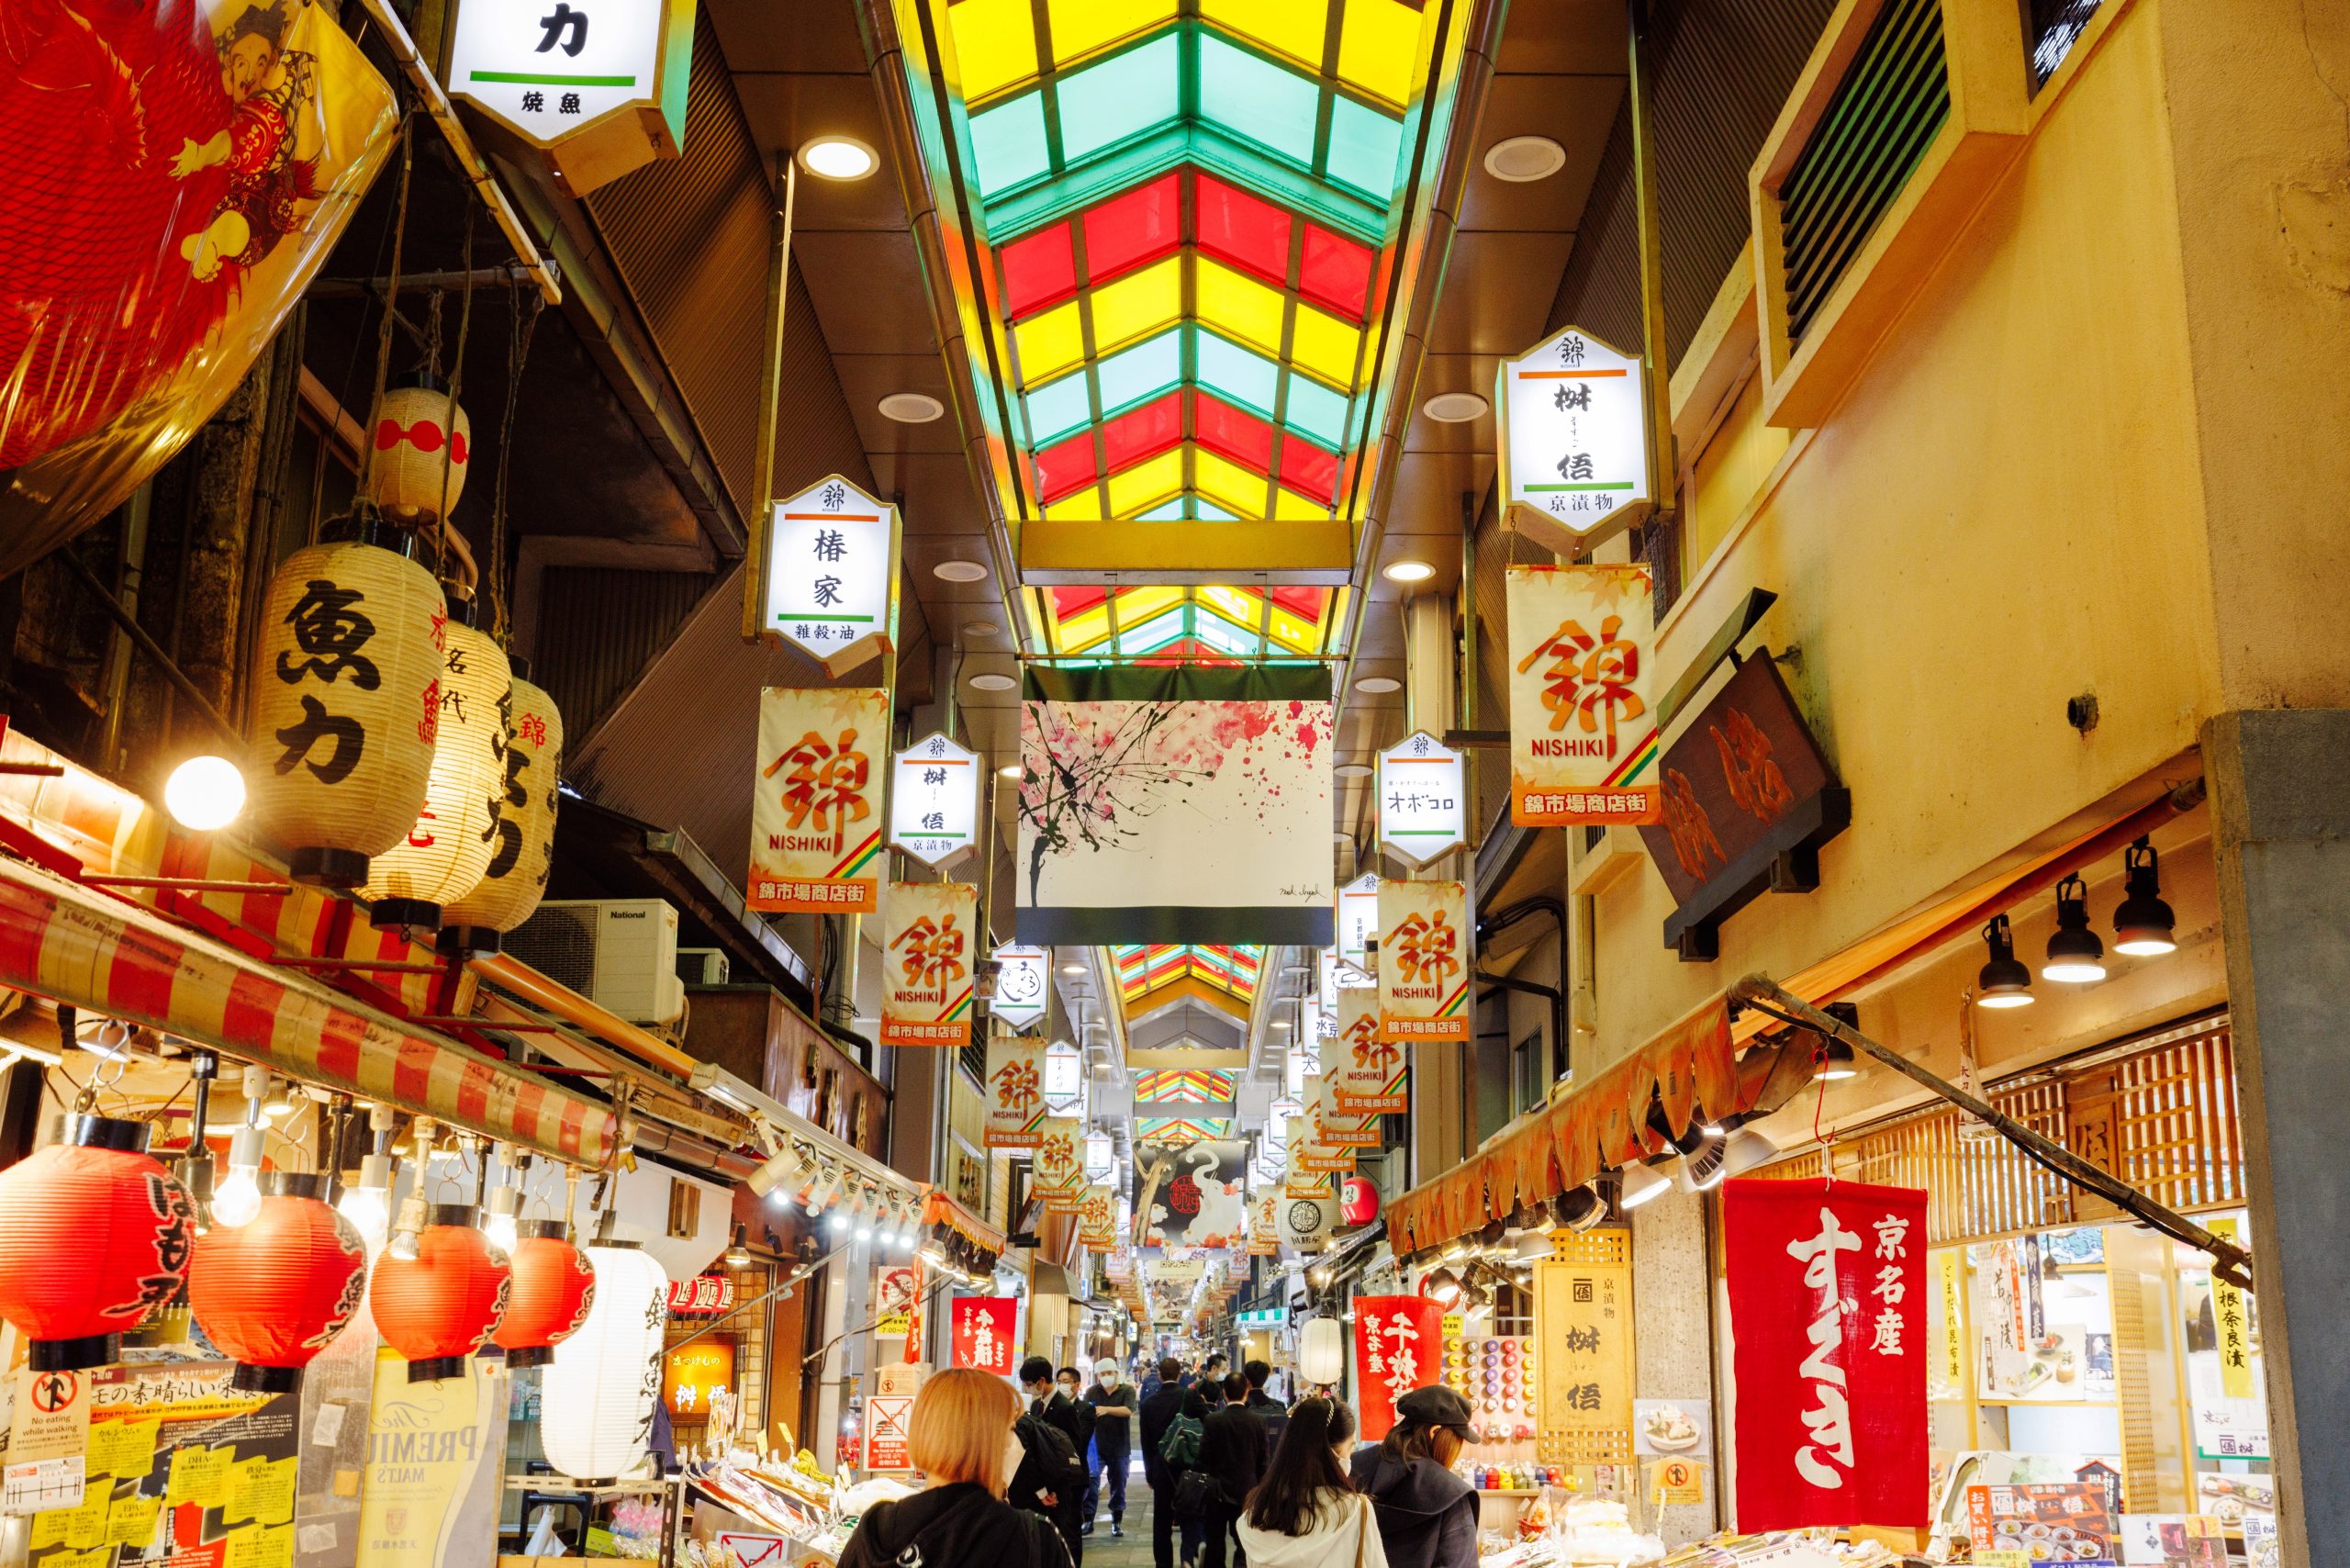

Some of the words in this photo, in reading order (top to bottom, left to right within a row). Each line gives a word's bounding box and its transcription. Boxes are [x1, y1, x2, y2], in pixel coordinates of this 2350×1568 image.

[534, 3, 589, 57] 力
[521, 92, 581, 114] 焼魚
[1556, 336, 1584, 367] 錦
[820, 485, 845, 512] 錦
[1549, 494, 1613, 511] 京漬物
[813, 529, 848, 608] 椿家
[795, 624, 855, 640] 雑穀・油
[275, 579, 382, 785] 魚力
[441, 647, 469, 724] 名代
[1516, 614, 1645, 762] 錦
[519, 711, 547, 750] 錦
[927, 738, 946, 758] 錦
[1411, 736, 1428, 756] 錦
[1531, 739, 1605, 756] NISHIKI
[764, 728, 869, 857] 錦
[1388, 791, 1454, 813] オボコロ
[1524, 793, 1647, 814] 錦市場商店街
[769, 834, 831, 852] NISHIKI
[912, 839, 952, 851] 京漬物
[758, 881, 865, 903] 錦市場商店街
[890, 913, 965, 1006] 錦
[1382, 910, 1460, 1002] 錦
[895, 991, 939, 1002] NISHIKI
[1392, 987, 1435, 999] NISHIKI
[888, 1025, 963, 1038] 錦市場商店街
[1387, 1021, 1461, 1034] 錦市場商店街
[1341, 1013, 1401, 1082] 錦
[1348, 1071, 1382, 1081] NISHIKI
[990, 1058, 1040, 1121] 錦
[1344, 1098, 1401, 1107] 錦市場商店街
[992, 1110, 1023, 1120] NISHIKI
[1328, 1110, 1360, 1119] NISHIKI
[989, 1134, 1038, 1143] 錦市場商店街
[1326, 1133, 1375, 1142] 錦市場商店街
[1042, 1133, 1073, 1181] 錦
[1307, 1159, 1351, 1168] 錦市場商店街
[1086, 1196, 1108, 1228] 錦
[1869, 1214, 1909, 1357] 京名産
[1603, 1278, 1616, 1319] 京漬物
[1363, 1314, 1387, 1373] 京名産
[1786, 1206, 1863, 1490] すぐき
[672, 1355, 721, 1366] 京つけもの
[23, 1428, 45, 1437] while
[46, 1424, 78, 1435] walking
[31, 1417, 43, 1425] No
[46, 1415, 71, 1425] eating
[1970, 1492, 1991, 1551] お買い得品
